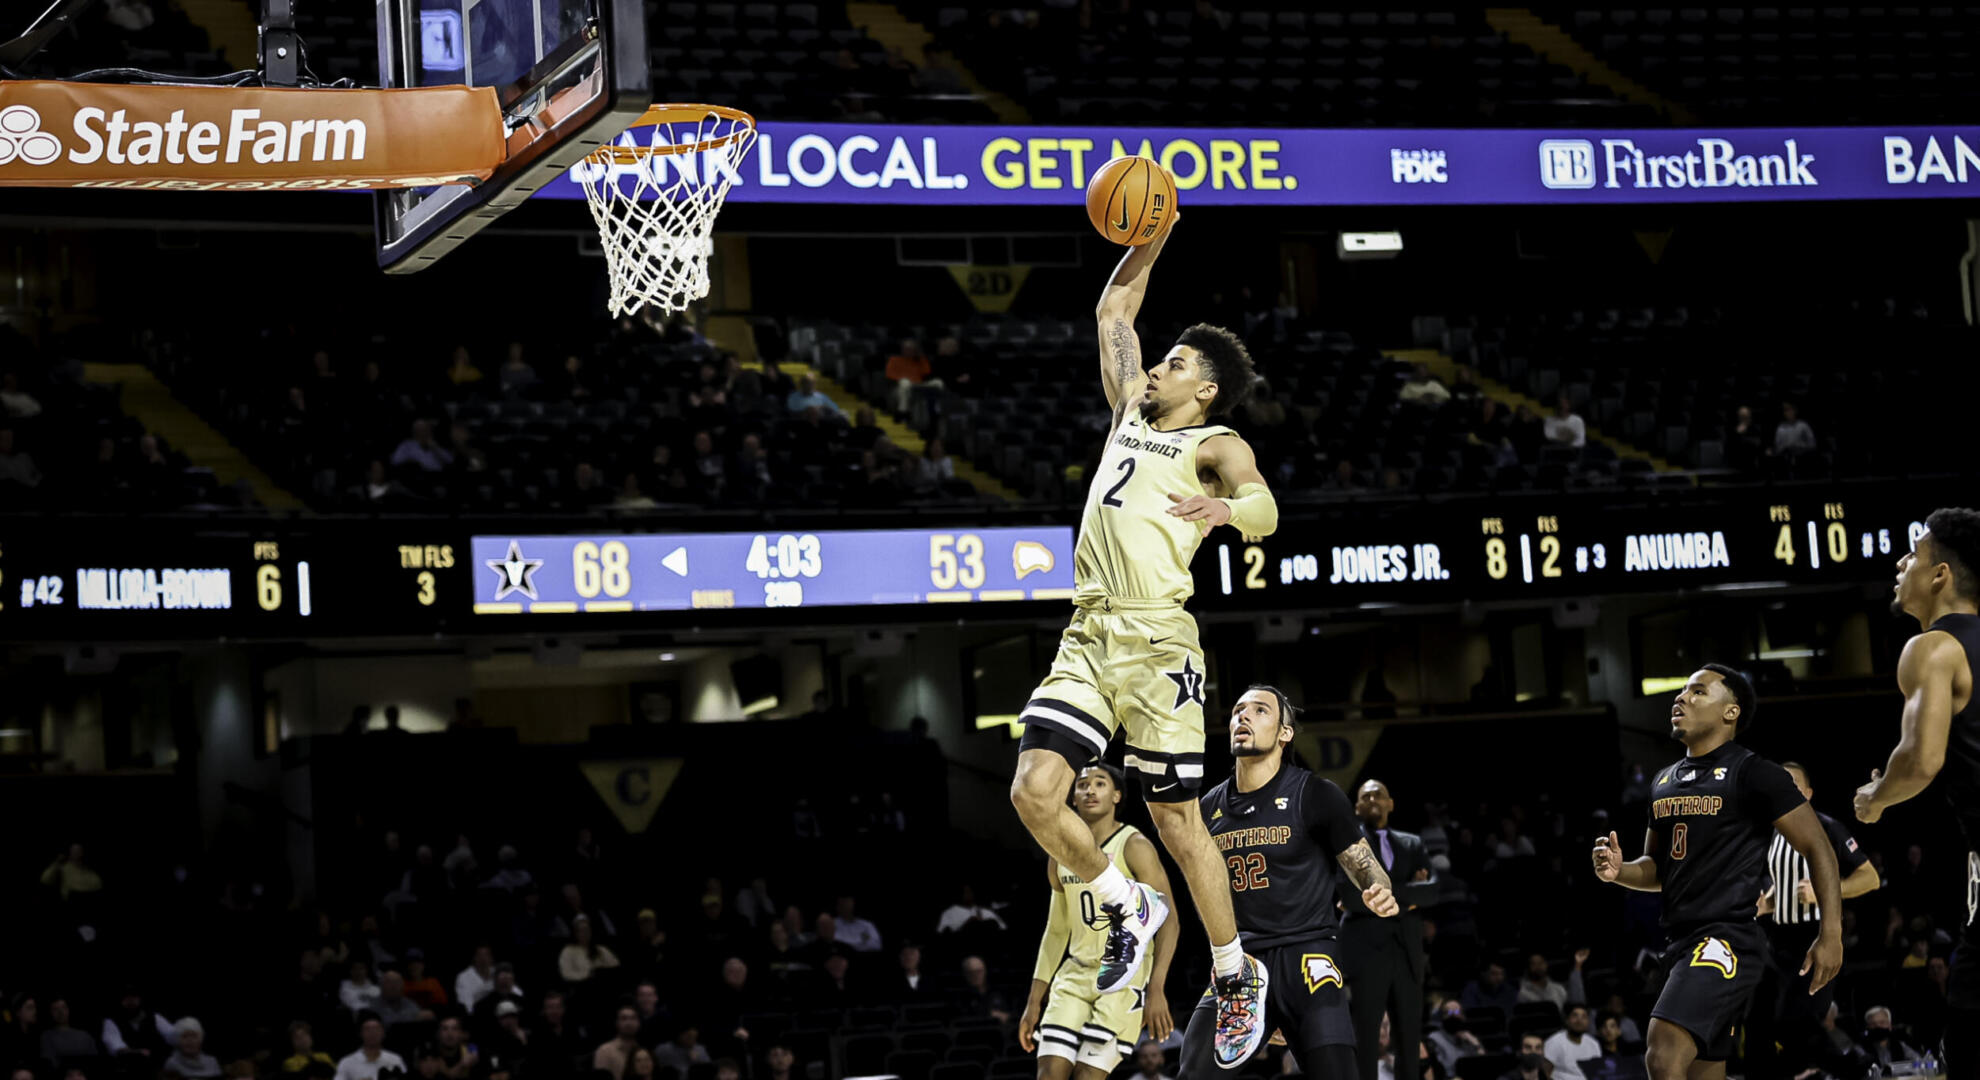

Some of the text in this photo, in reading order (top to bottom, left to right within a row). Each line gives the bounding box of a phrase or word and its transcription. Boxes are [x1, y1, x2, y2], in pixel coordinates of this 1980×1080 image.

[758, 135, 968, 190] LOCAL.
[981, 139, 1093, 190] GET
[1392, 158, 1448, 183] FDIC
[1141, 194, 1165, 238] ELITE
[968, 271, 1014, 297] 2D
[1102, 457, 1136, 508] 2
[424, 545, 455, 568] FLS
[745, 533, 823, 578] 4:03
[929, 534, 986, 589] 53
[1540, 535, 1562, 578] 2
[1625, 531, 1730, 571] ANUMBA
[1774, 524, 1796, 565] 4
[1827, 522, 1848, 563] 0
[572, 540, 631, 598] 68
[1244, 538, 1508, 589] 2 #00 JONES JR. 8
[20, 575, 64, 608] #42
[257, 563, 282, 611] 6
[417, 571, 436, 606] 3
[1317, 737, 1353, 770] D
[615, 767, 651, 806] C
[1671, 823, 1688, 860] 0
[1228, 852, 1270, 892] 32
[1080, 890, 1096, 926] 0
